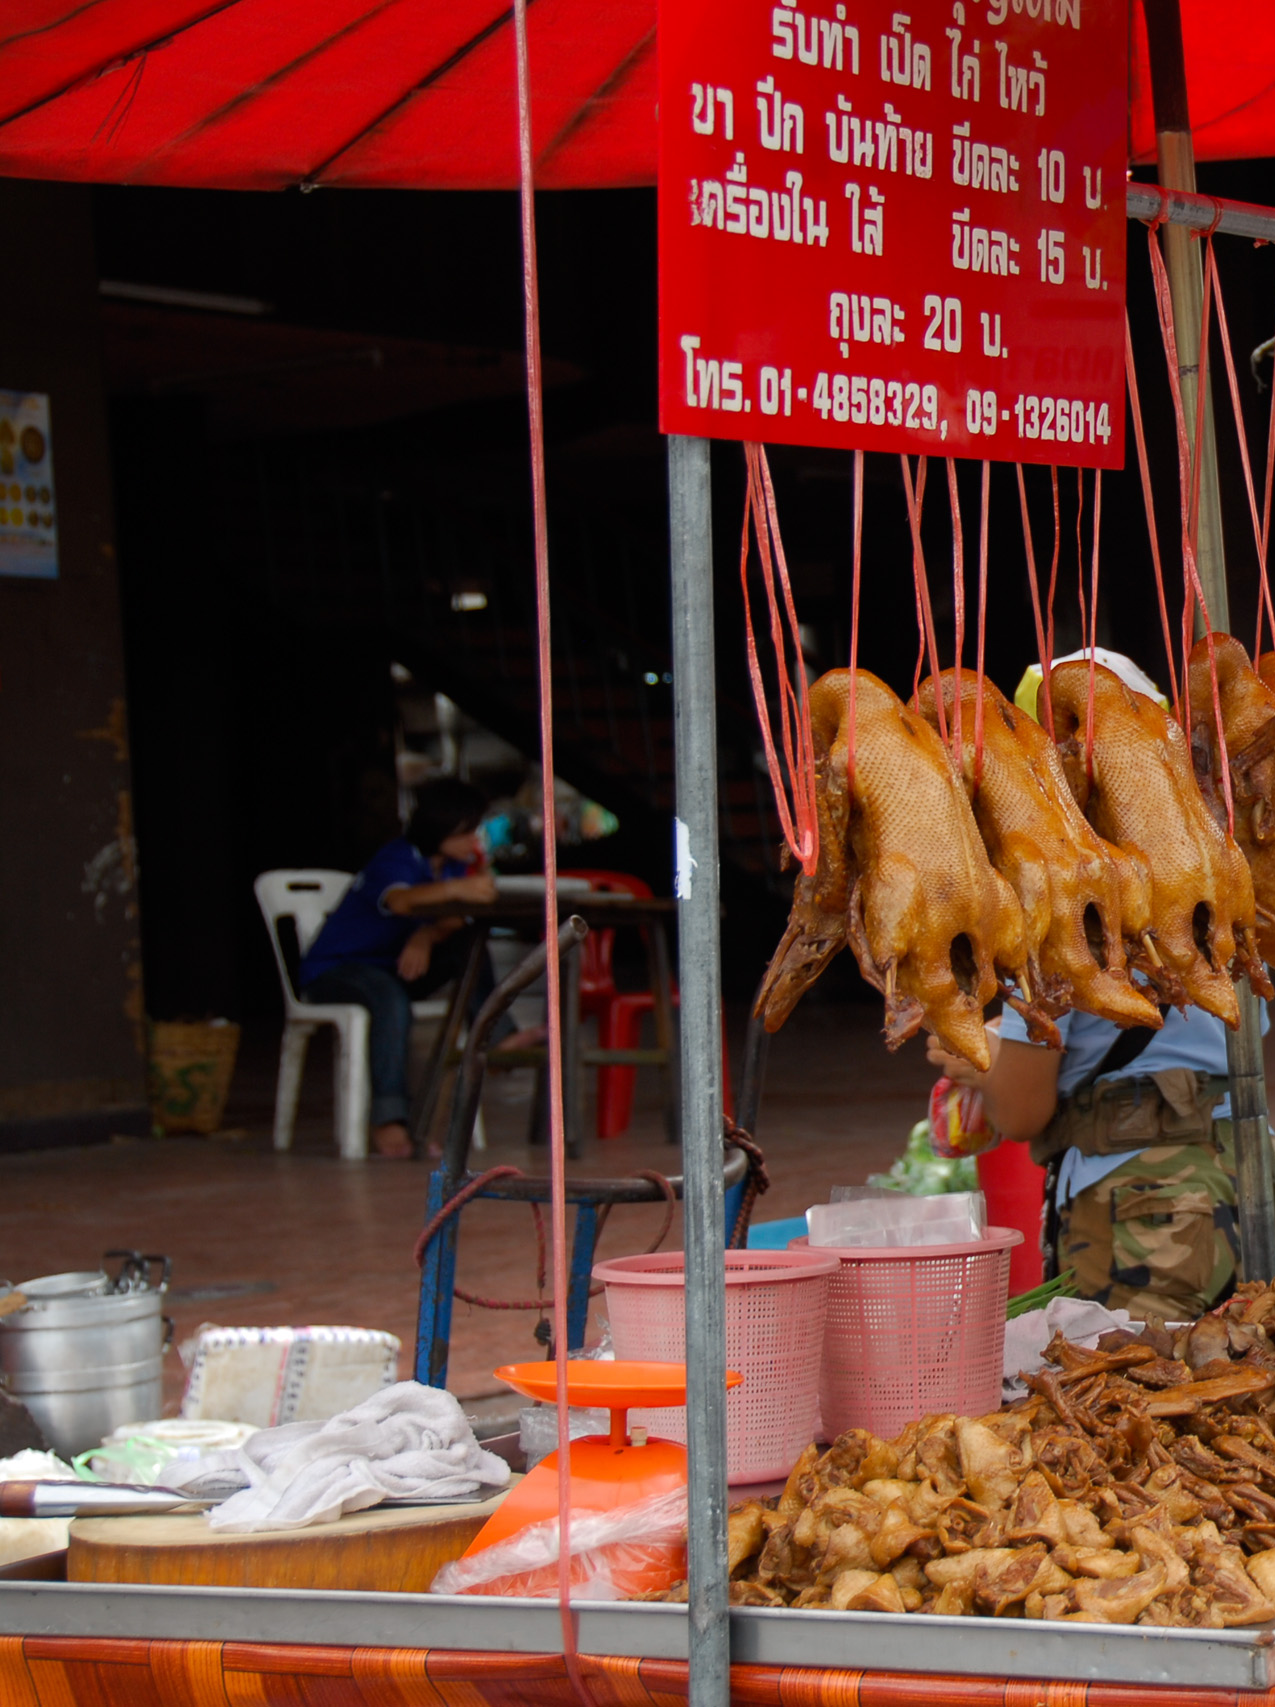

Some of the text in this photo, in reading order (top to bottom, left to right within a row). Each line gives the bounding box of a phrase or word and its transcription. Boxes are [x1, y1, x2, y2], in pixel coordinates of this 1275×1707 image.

[881, 13, 931, 91] เป็ด
[946, 28, 980, 102] ไก่
[995, 41, 1048, 116] ไหว้
[692, 83, 733, 140] ขา
[757, 75, 804, 154] ปีก
[826, 94, 932, 179] บันท้าย
[953, 122, 1019, 193] ขีดละ
[1038, 148, 1065, 203] 10
[690, 152, 1107, 290] เครื่องใน ใส้ ขีดละ 15 บ.
[680, 335, 751, 412] โทร.
[830, 292, 1008, 358] ถุงละ 20 บ.
